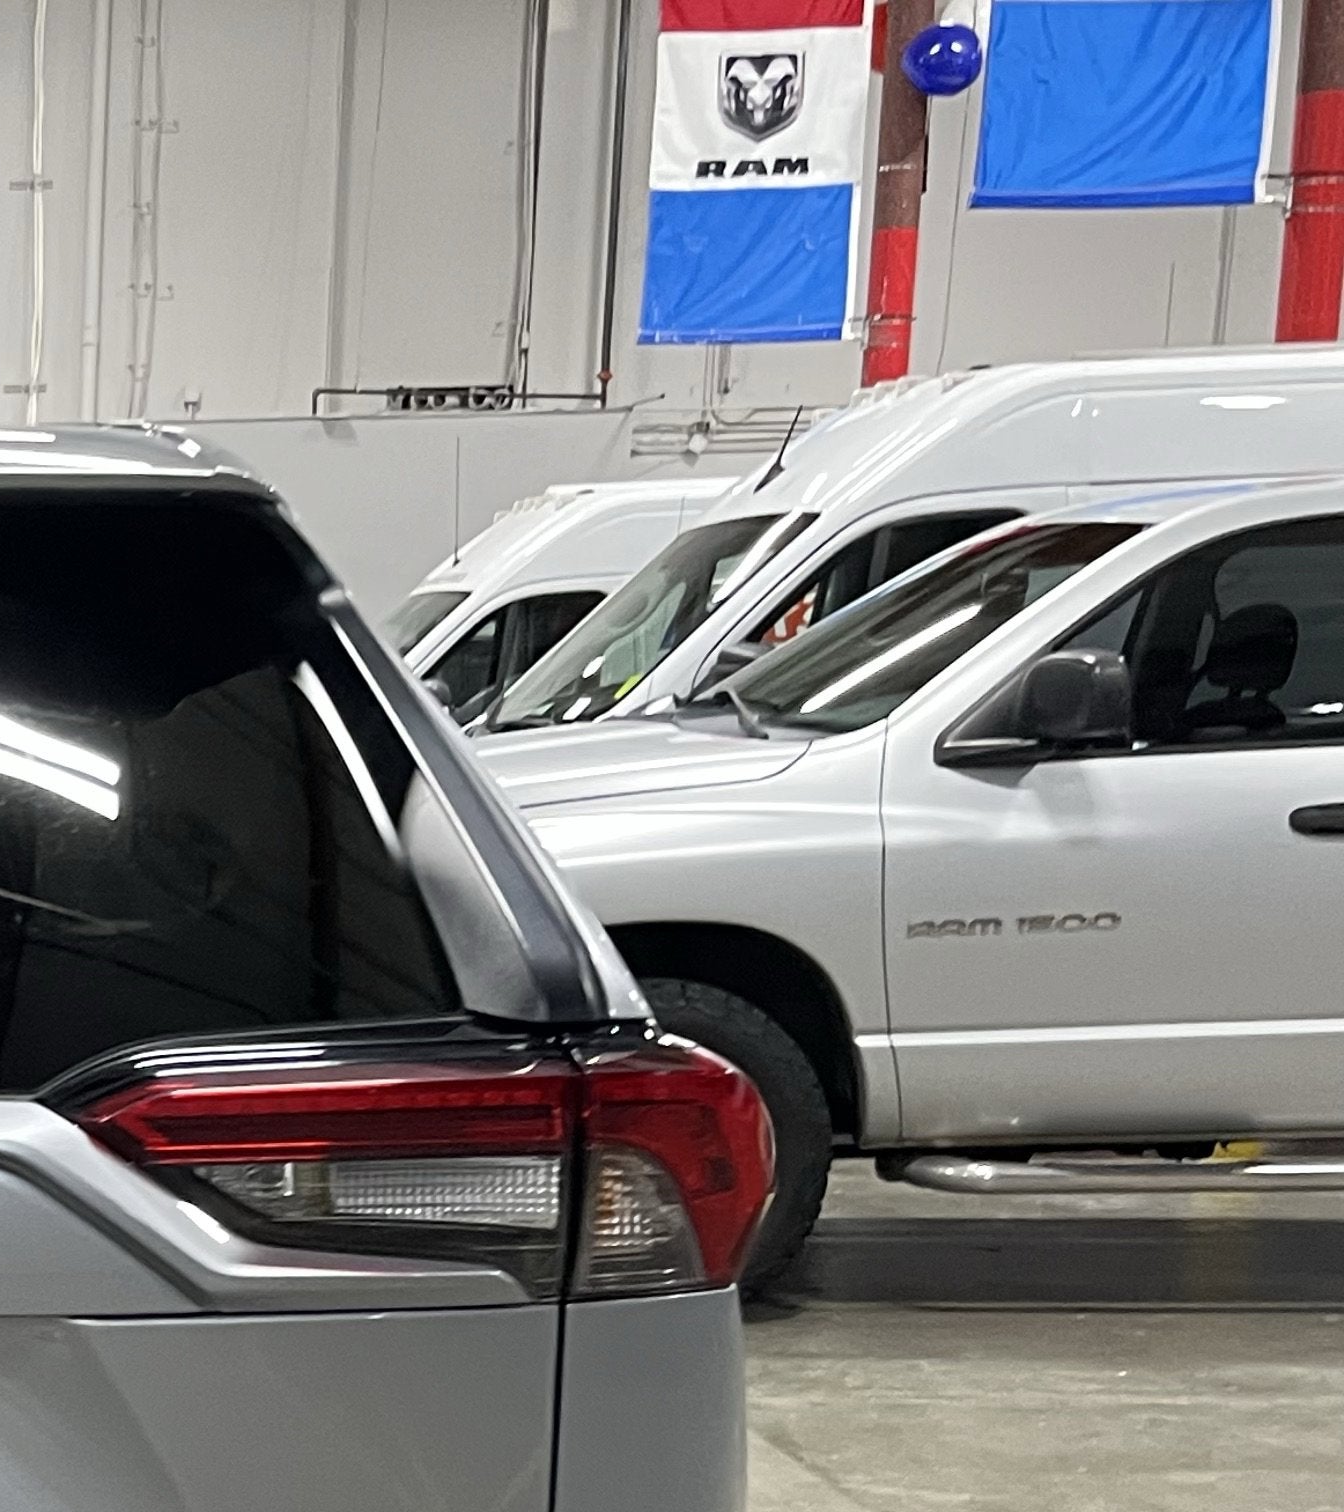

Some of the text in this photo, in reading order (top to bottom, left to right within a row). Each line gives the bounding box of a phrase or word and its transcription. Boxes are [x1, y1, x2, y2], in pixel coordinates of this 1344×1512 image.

[696, 158, 809, 178] RAM
[907, 912, 1121, 938] RAM 1500
